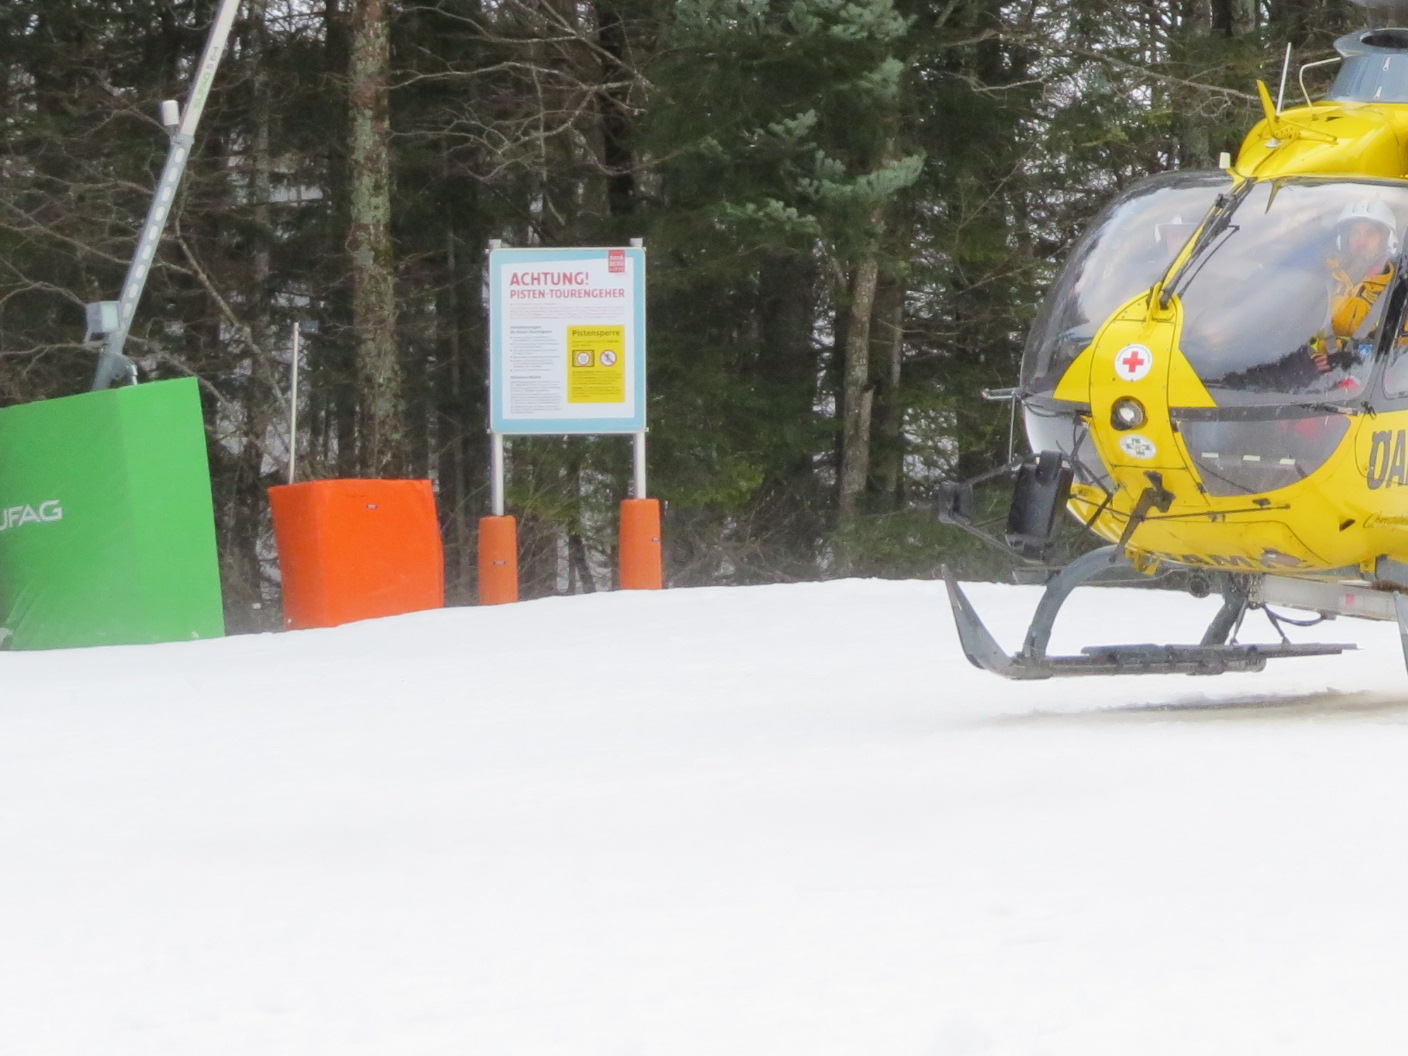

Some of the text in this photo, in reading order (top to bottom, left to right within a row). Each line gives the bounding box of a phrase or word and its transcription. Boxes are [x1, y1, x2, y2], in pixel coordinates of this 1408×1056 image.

[509, 271, 589, 286] ACHTUNG!
[510, 288, 625, 299] PISTEN-TOURENGEHER
[572, 329, 620, 337] Pistensperre
